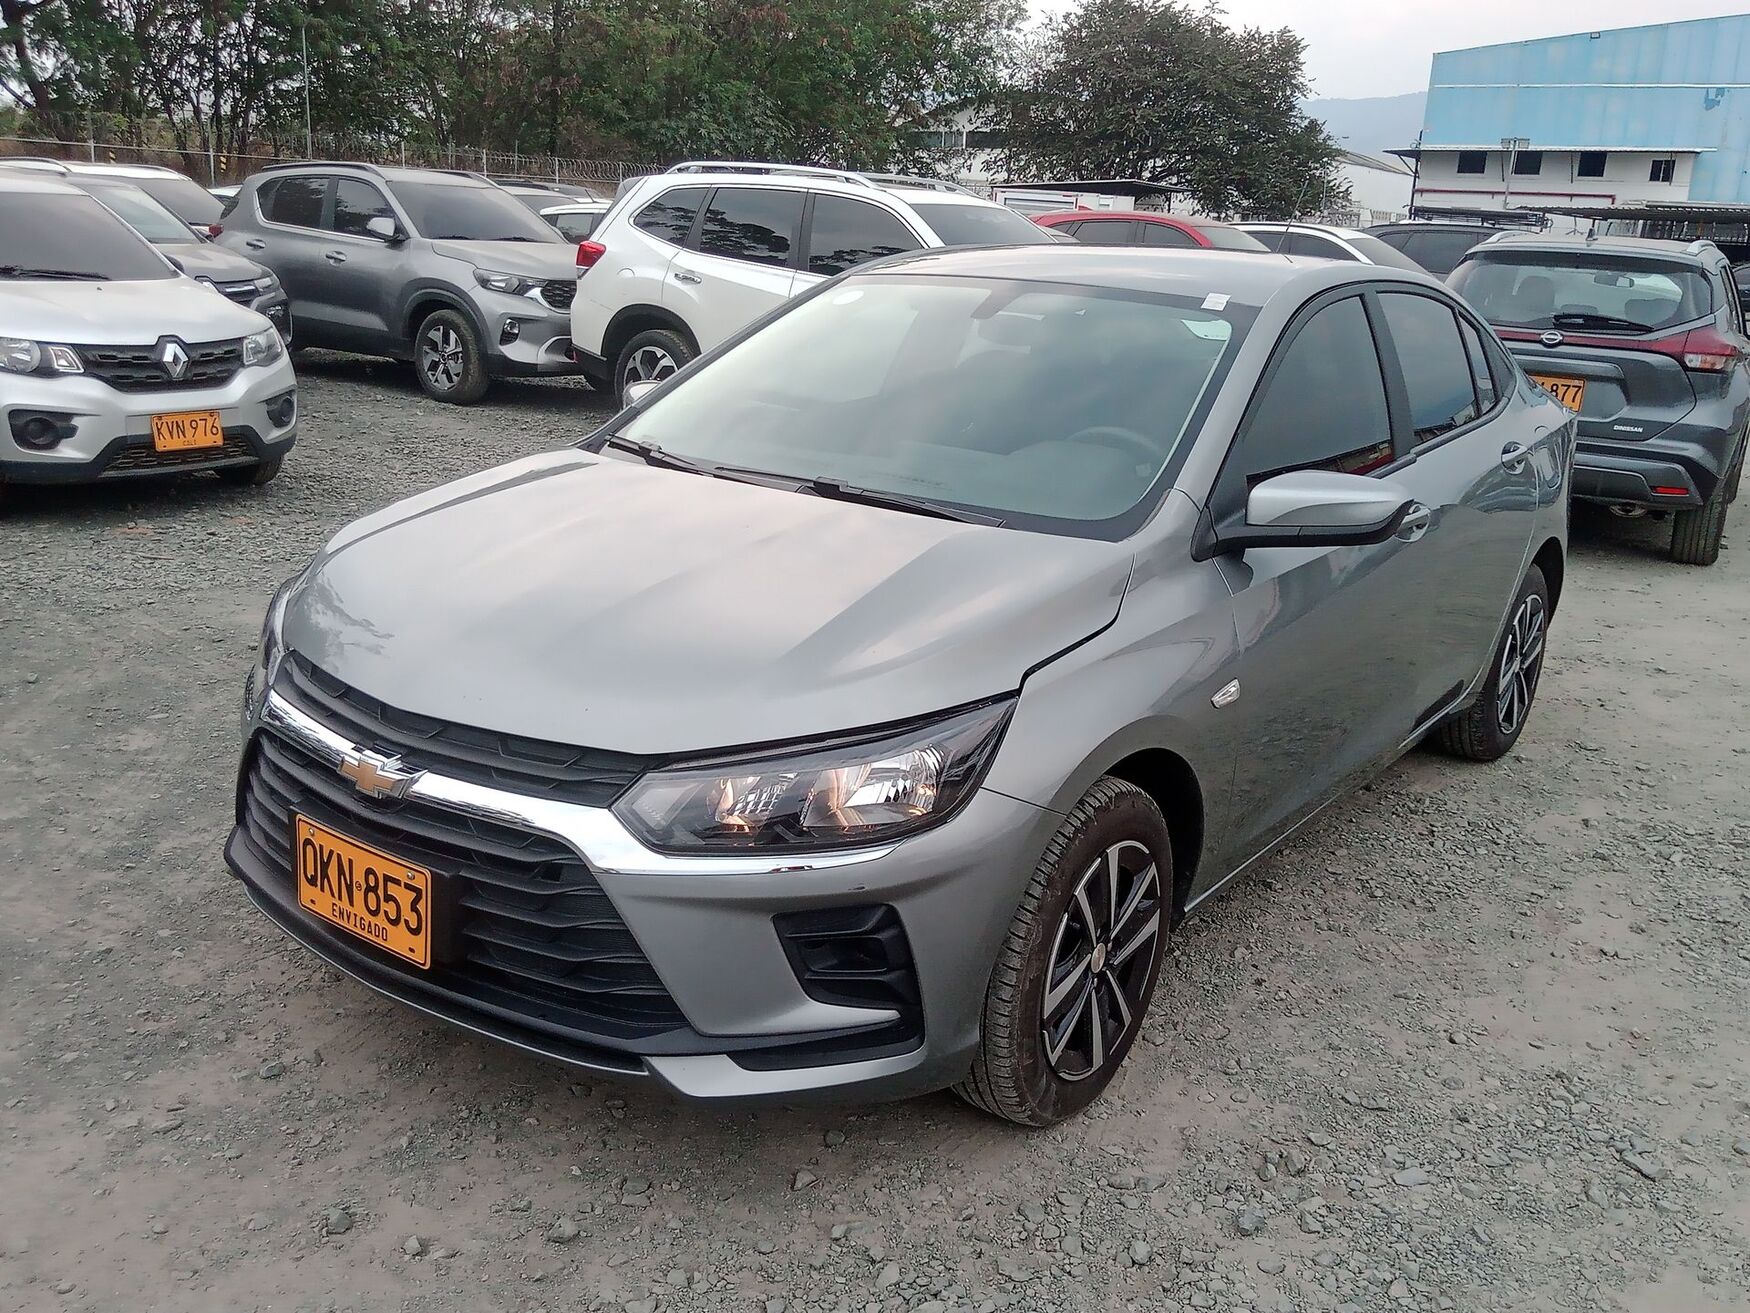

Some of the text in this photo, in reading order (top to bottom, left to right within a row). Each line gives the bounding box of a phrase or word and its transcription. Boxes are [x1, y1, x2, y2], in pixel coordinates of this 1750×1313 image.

[156, 417, 219, 441] KVN 976
[302, 837, 423, 936] QKN 853
[331, 903, 388, 942] ENVIGADO
